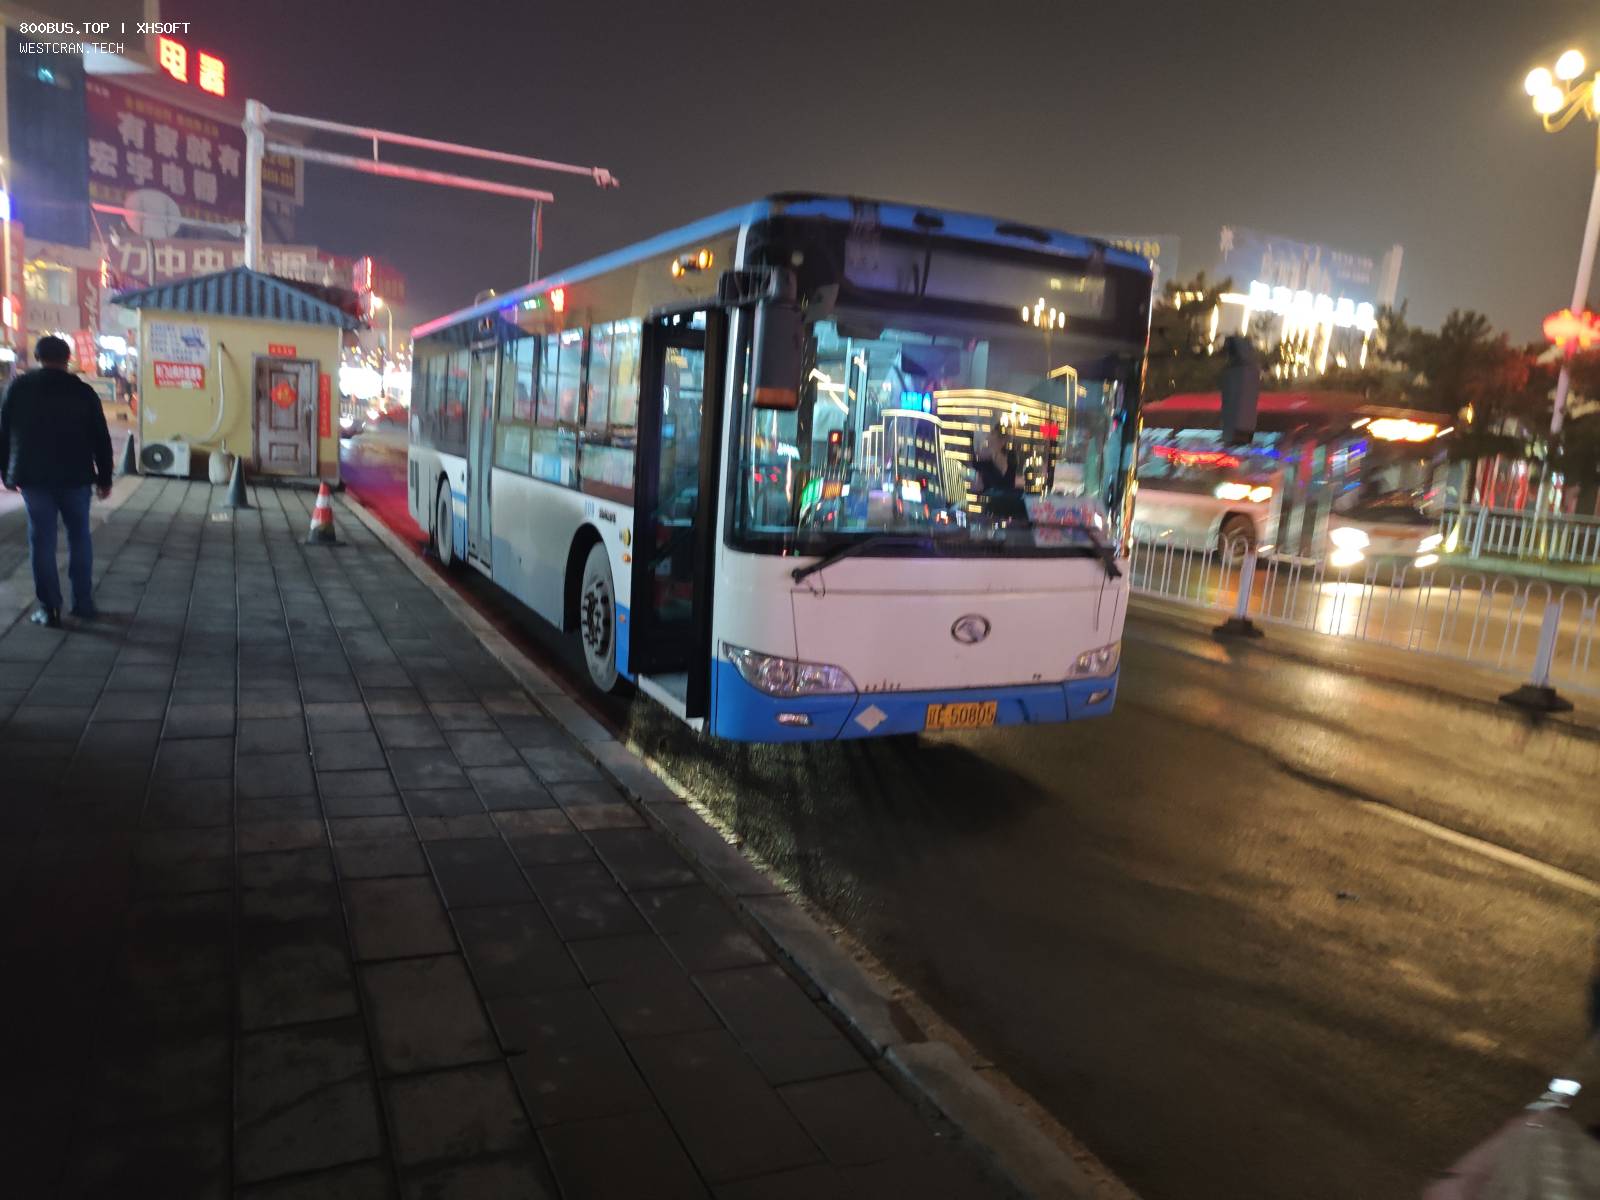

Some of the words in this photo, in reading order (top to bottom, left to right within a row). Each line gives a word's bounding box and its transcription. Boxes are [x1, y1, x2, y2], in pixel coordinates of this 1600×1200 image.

[158, 36, 226, 97] 电器
[118, 242, 308, 280] 力中央调
